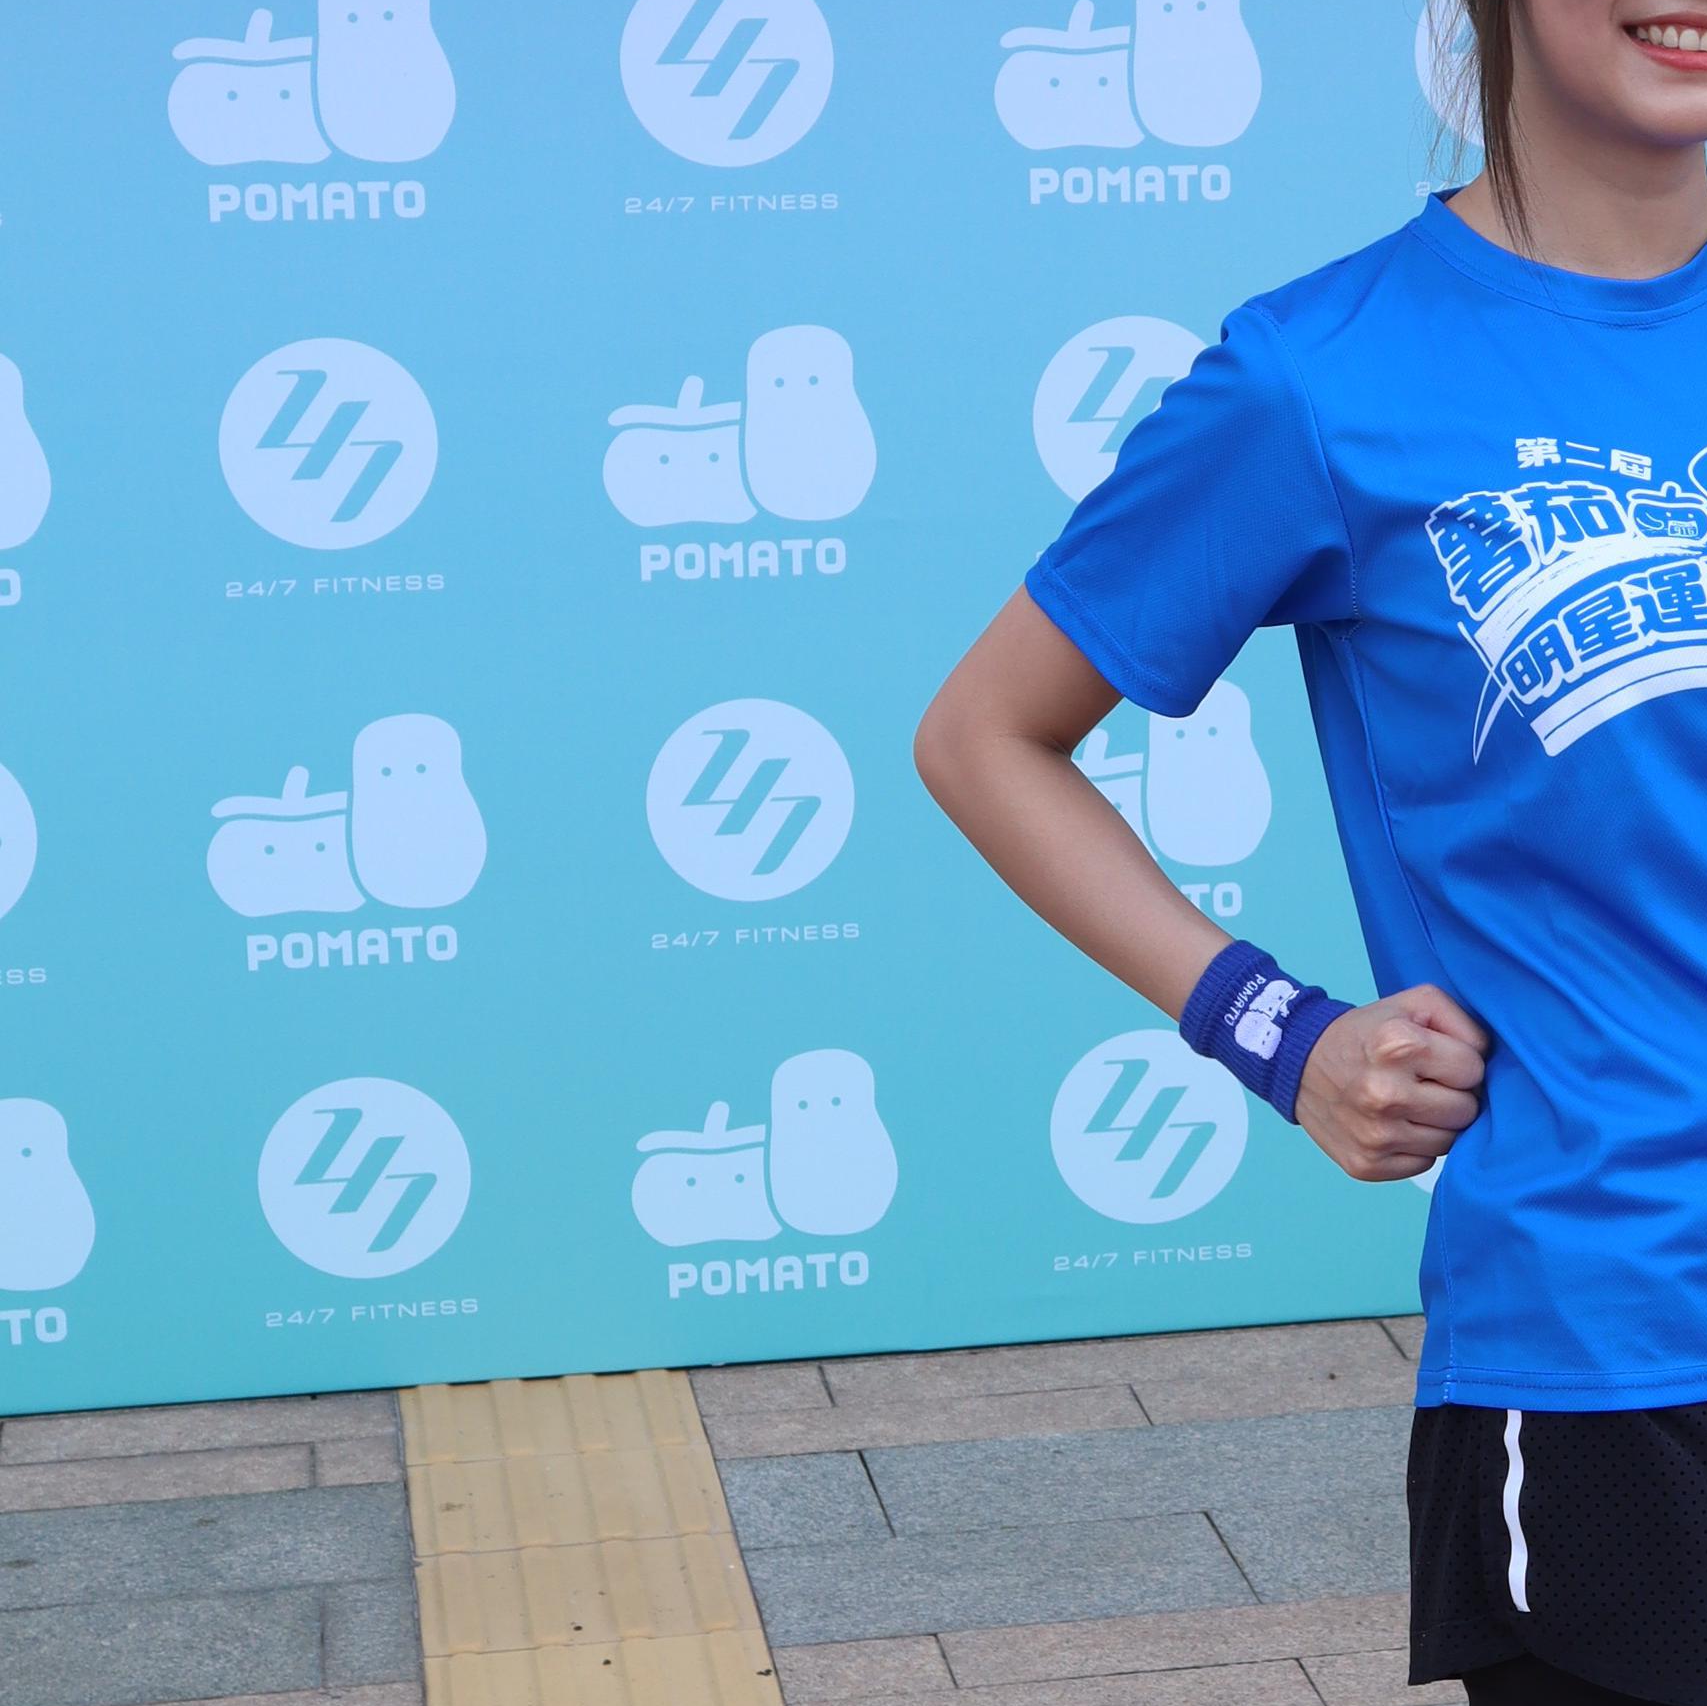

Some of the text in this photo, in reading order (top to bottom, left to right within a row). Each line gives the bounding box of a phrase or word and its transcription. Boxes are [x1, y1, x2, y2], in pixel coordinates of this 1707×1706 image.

[209, 181, 425, 222] POMATO
[625, 194, 838, 213] 24/7 FITNESS
[1030, 165, 1230, 204] POMATO
[1514, 436, 1652, 482] 第二屆
[641, 538, 846, 581] POMATO
[226, 574, 444, 598] 24/7 FITNESS
[247, 925, 457, 971] POMATO
[652, 923, 859, 949] 24/7 FITNESS
[669, 1251, 868, 1298] POMATO
[1054, 1243, 1252, 1271] 24/7 FITNESS
[266, 1299, 478, 1328] 24/7 FITNESS
